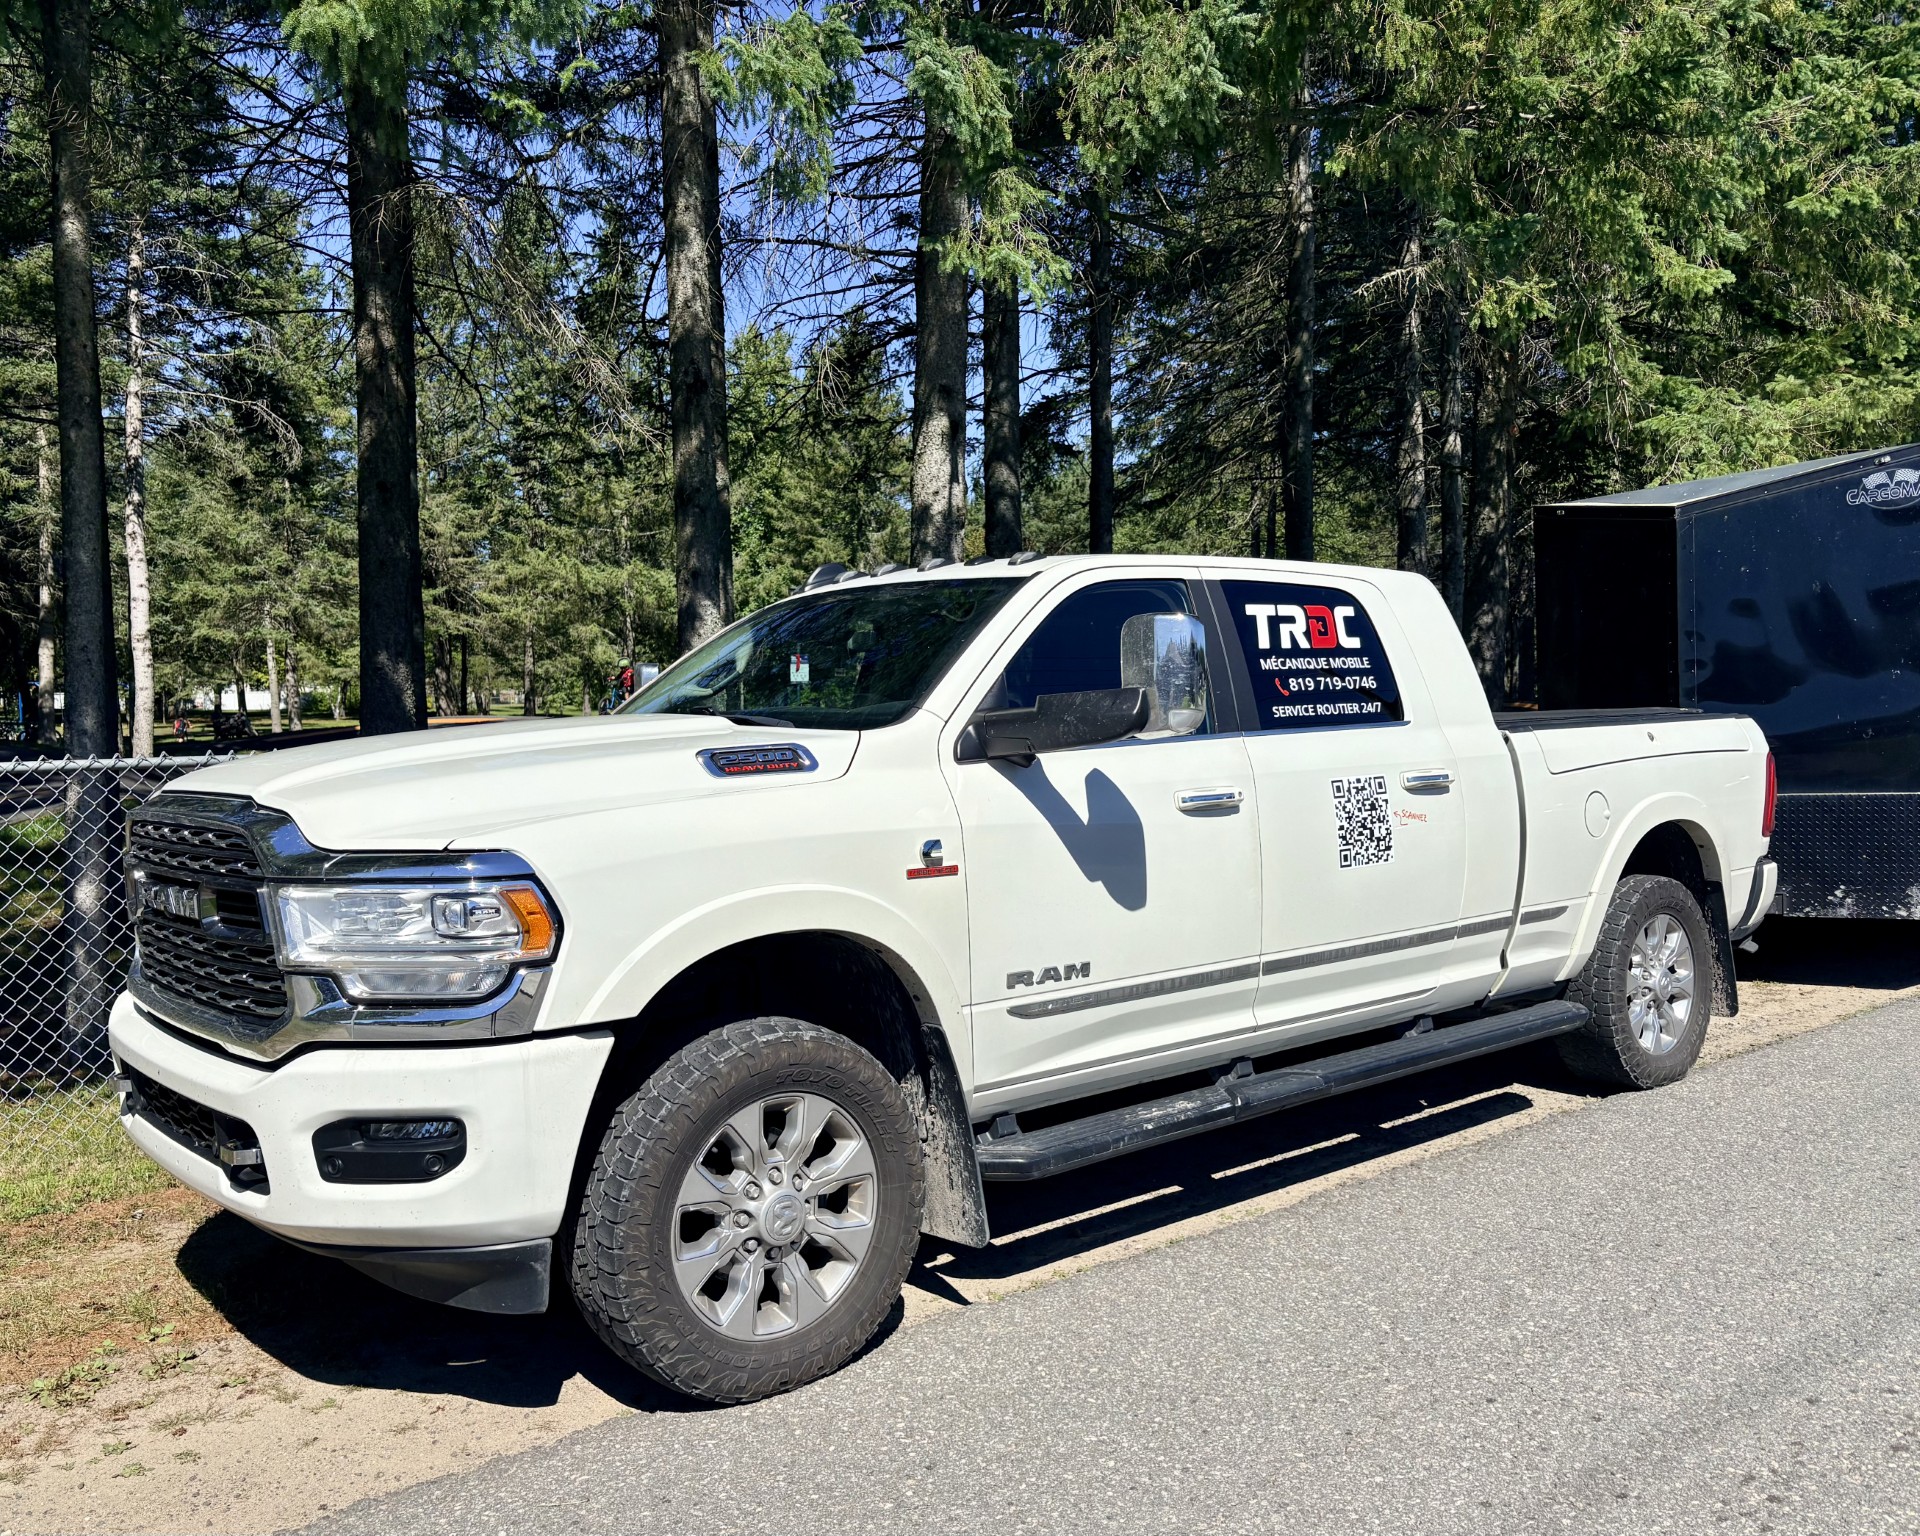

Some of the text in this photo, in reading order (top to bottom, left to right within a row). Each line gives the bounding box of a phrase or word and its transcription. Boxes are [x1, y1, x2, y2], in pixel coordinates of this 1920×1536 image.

[1260, 656, 1371, 670] MÉCANIQUE MOBILE
[1289, 676, 1377, 691] 819 719-0746
[1272, 702, 1382, 718] SERVICE ROUTIER 24/7
[719, 751, 794, 765] 2500
[725, 762, 799, 773] HEAVY DUTY
[1006, 961, 1091, 989] RAM
